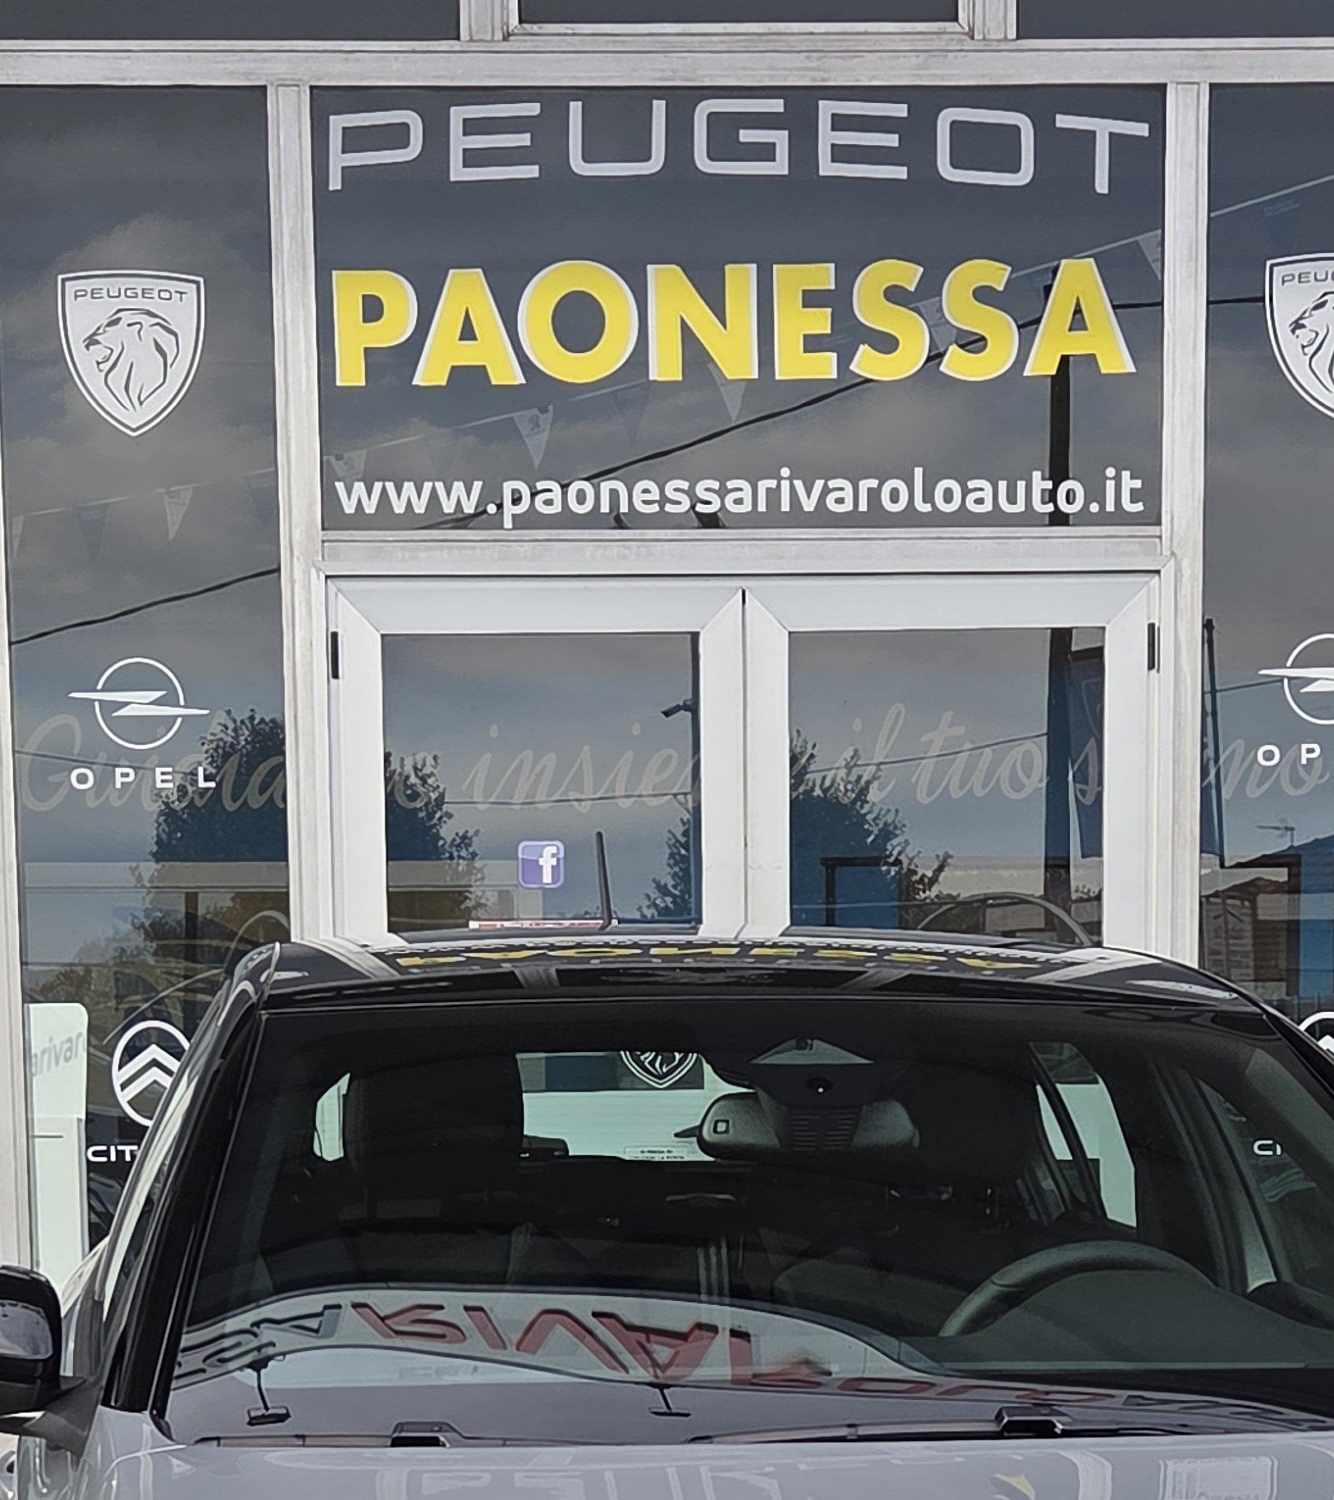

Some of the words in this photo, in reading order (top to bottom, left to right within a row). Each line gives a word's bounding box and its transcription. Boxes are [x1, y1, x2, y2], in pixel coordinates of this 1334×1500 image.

[328, 98, 1150, 194] PEUGEOT
[73, 286, 189, 303] PEUGEOT
[331, 257, 1137, 388] PAONESSA
[333, 466, 1146, 530] www.paonessarivaroloauto.it
[69, 766, 217, 790] OPEL
[86, 1144, 139, 1163] CIT
